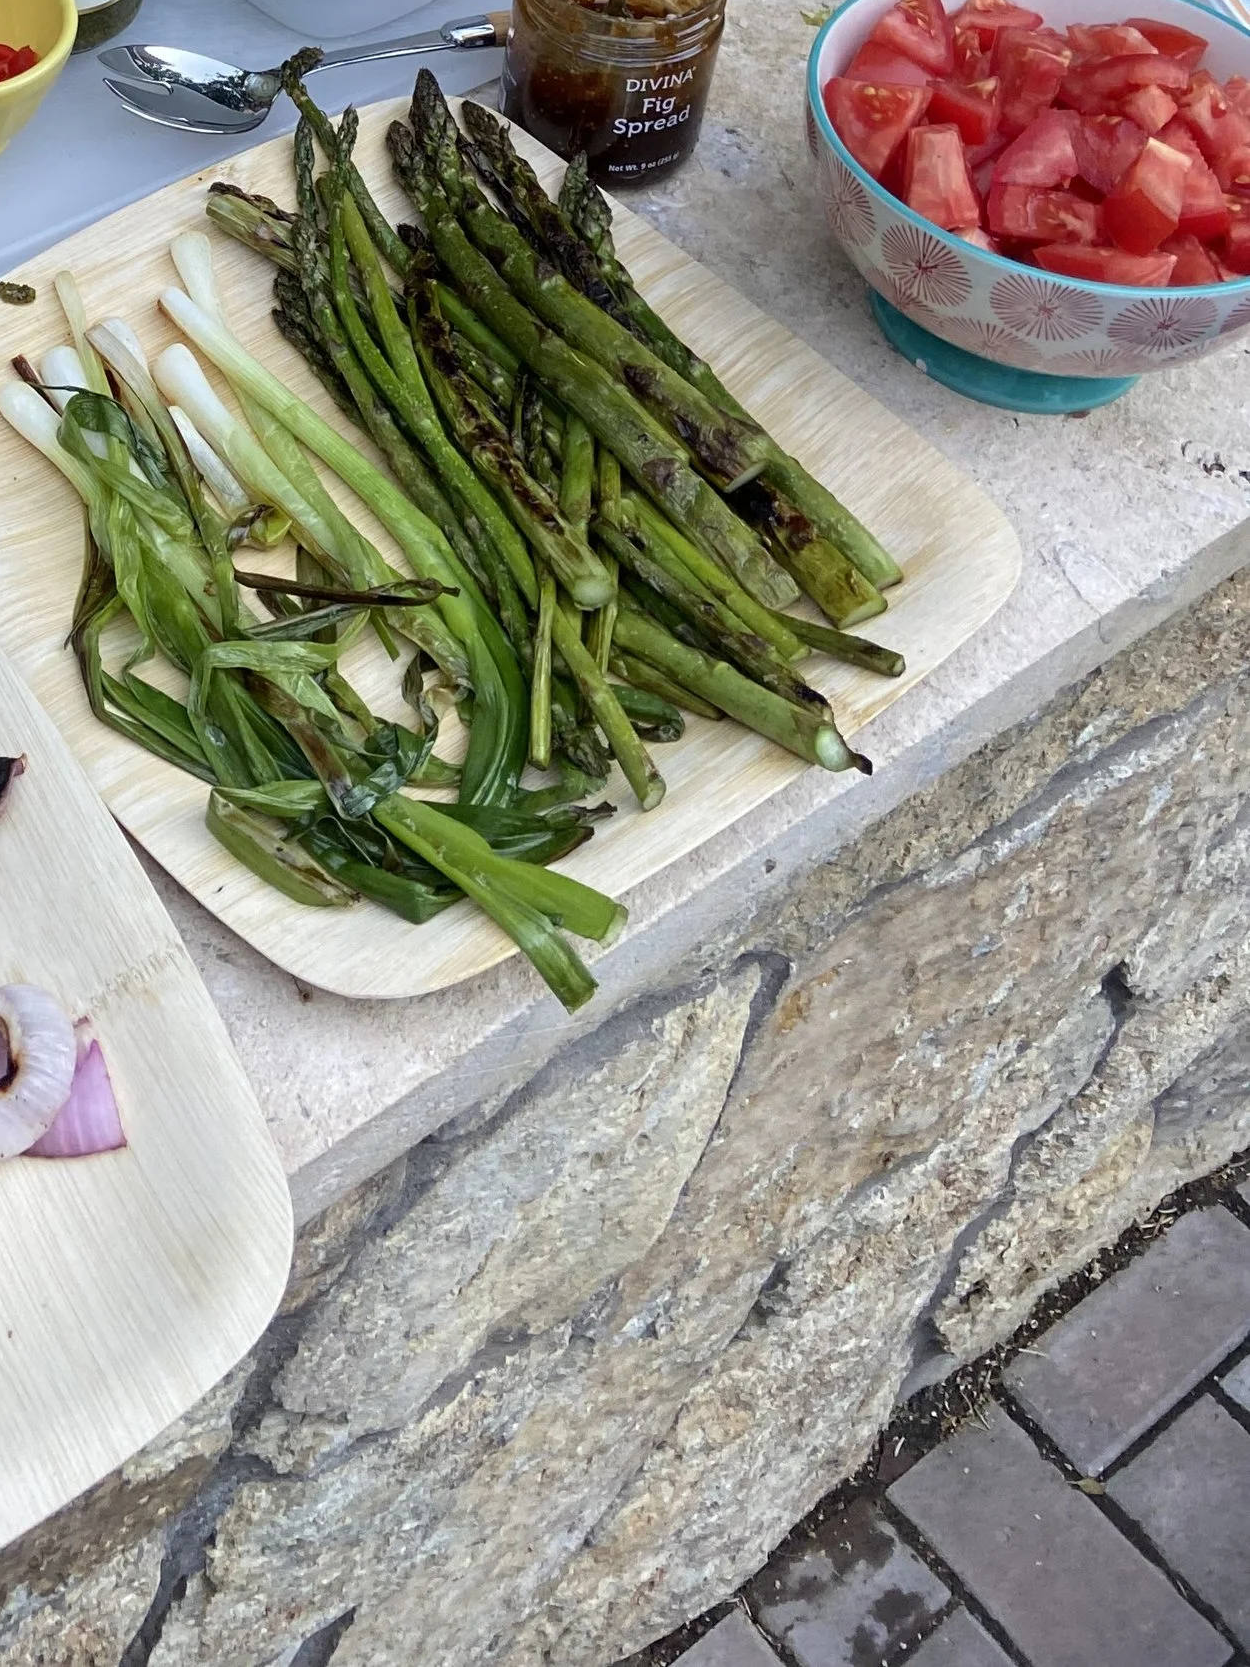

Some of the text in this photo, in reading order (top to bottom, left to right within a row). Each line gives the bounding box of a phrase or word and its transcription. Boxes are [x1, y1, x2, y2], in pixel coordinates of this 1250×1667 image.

[625, 69, 694, 92] DIVINA
[642, 96, 677, 114] Fig
[613, 104, 691, 138] Spread
